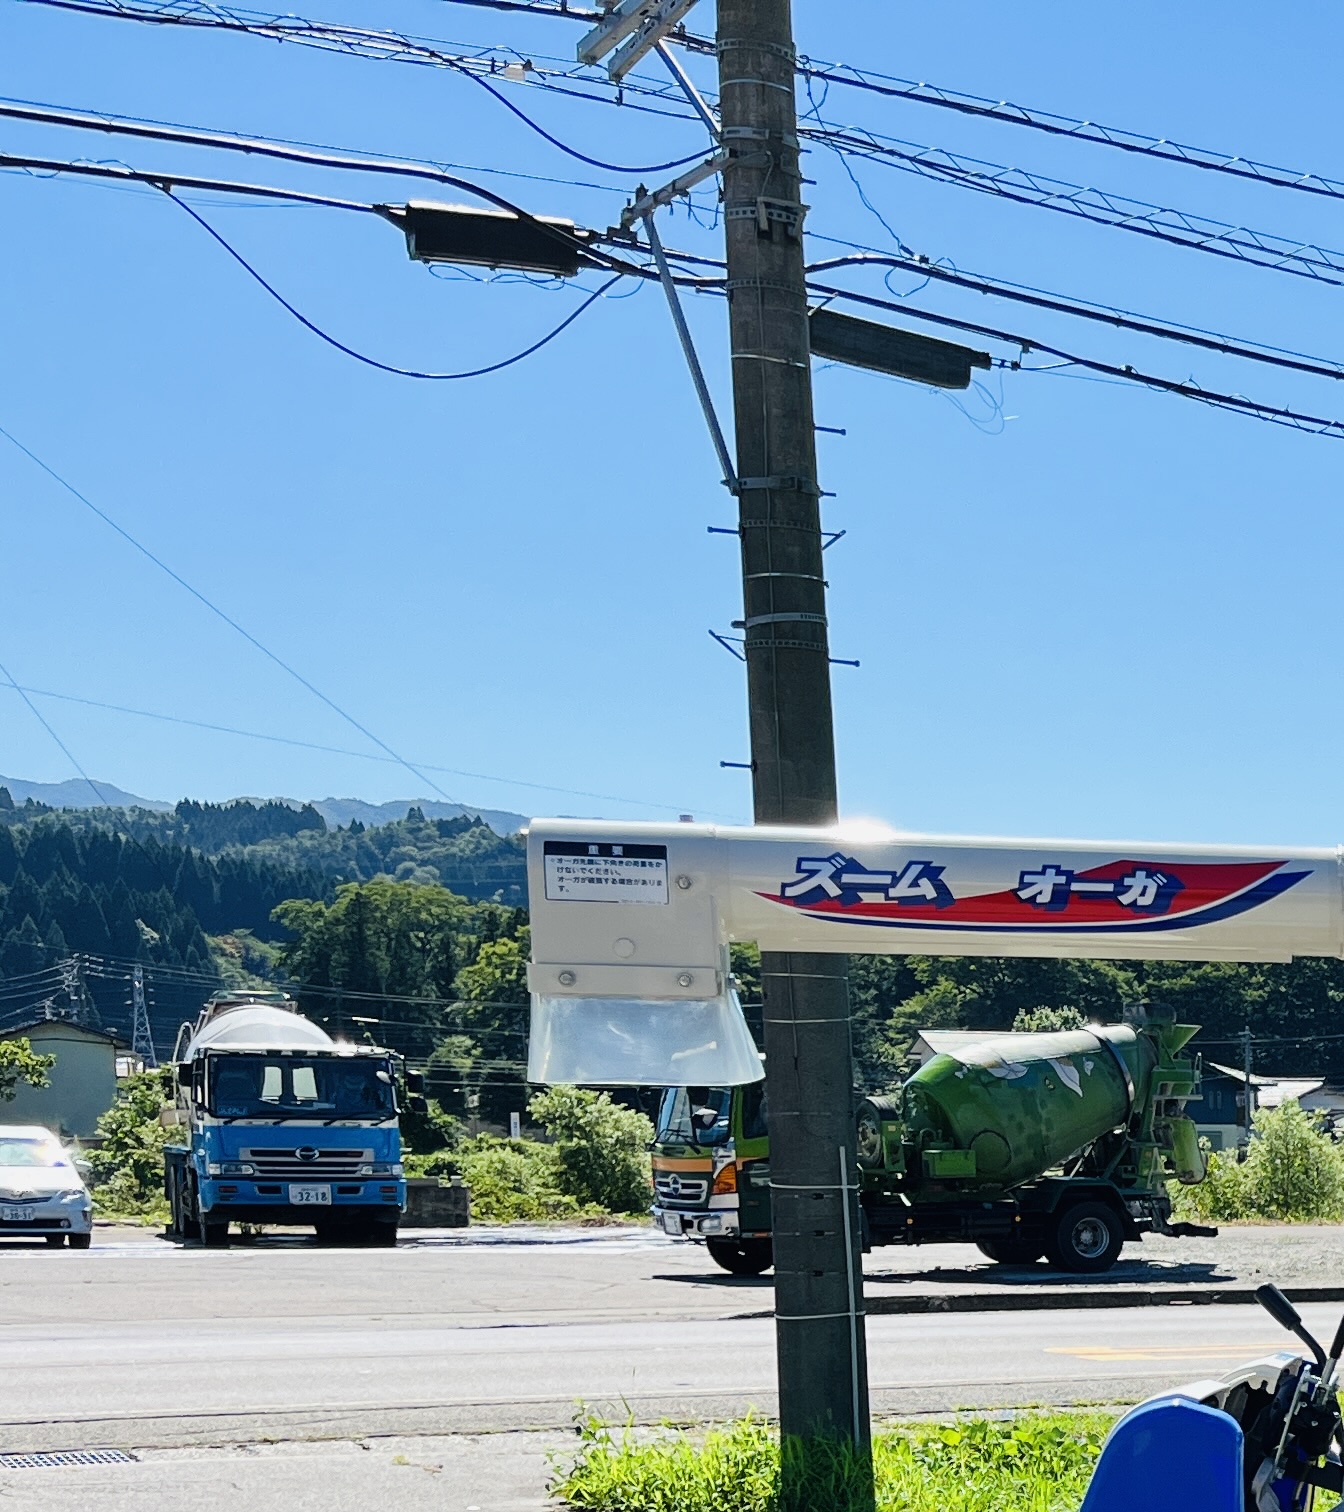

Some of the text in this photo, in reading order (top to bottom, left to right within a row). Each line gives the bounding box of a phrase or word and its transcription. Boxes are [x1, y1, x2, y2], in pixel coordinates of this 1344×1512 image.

[784, 857, 1168, 907] ズーム オーガ
